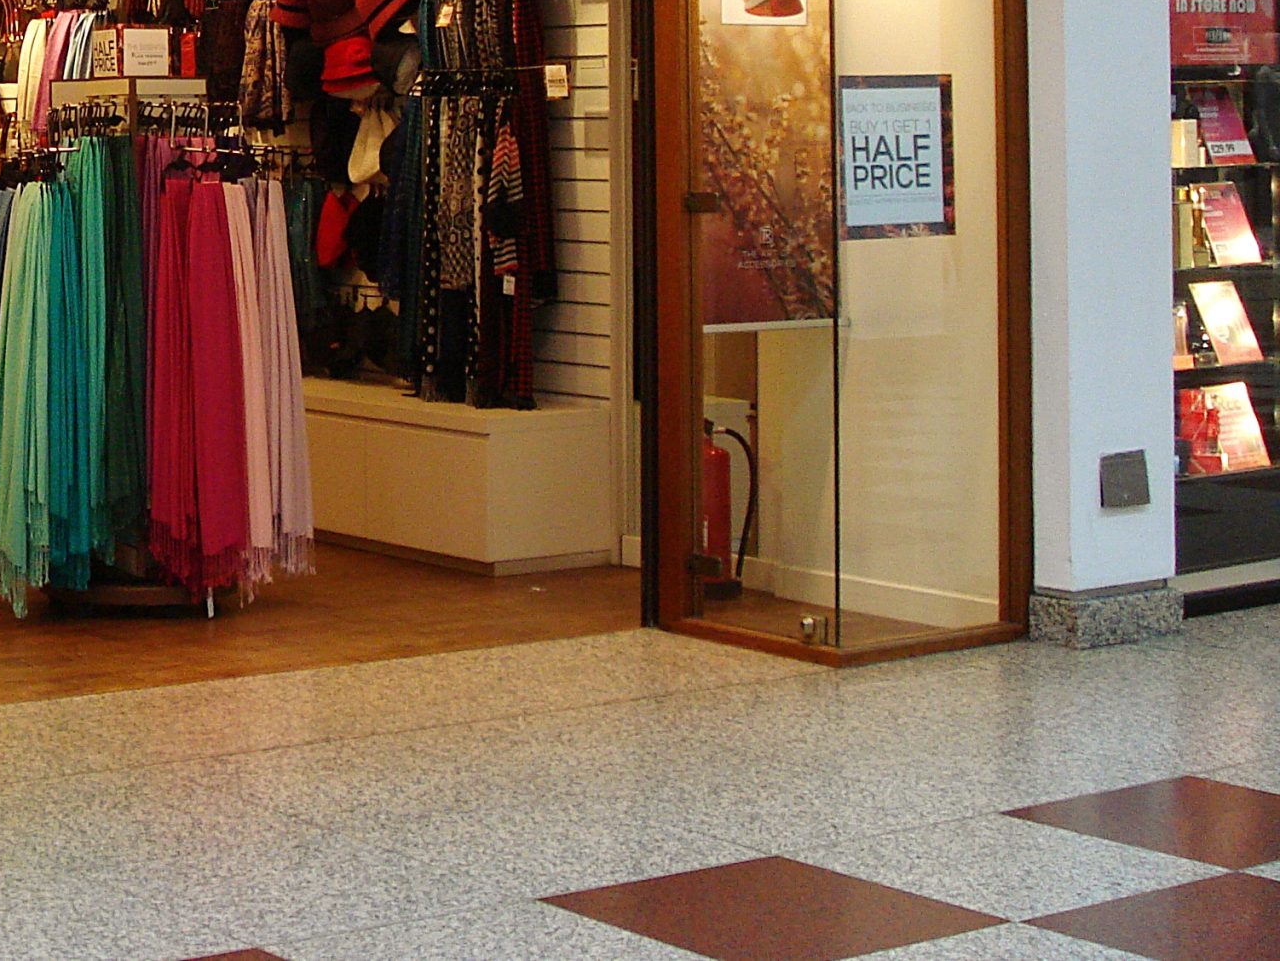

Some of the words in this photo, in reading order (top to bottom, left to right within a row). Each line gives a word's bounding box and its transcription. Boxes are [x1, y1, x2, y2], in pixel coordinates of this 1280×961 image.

[94, 56, 116, 72] PRICE
[850, 120, 879, 135] BUY
[882, 120, 889, 133] 1
[892, 119, 920, 133] GET
[926, 119, 932, 131] 1
[852, 134, 931, 163] HALF
[853, 163, 931, 190] PRICE
